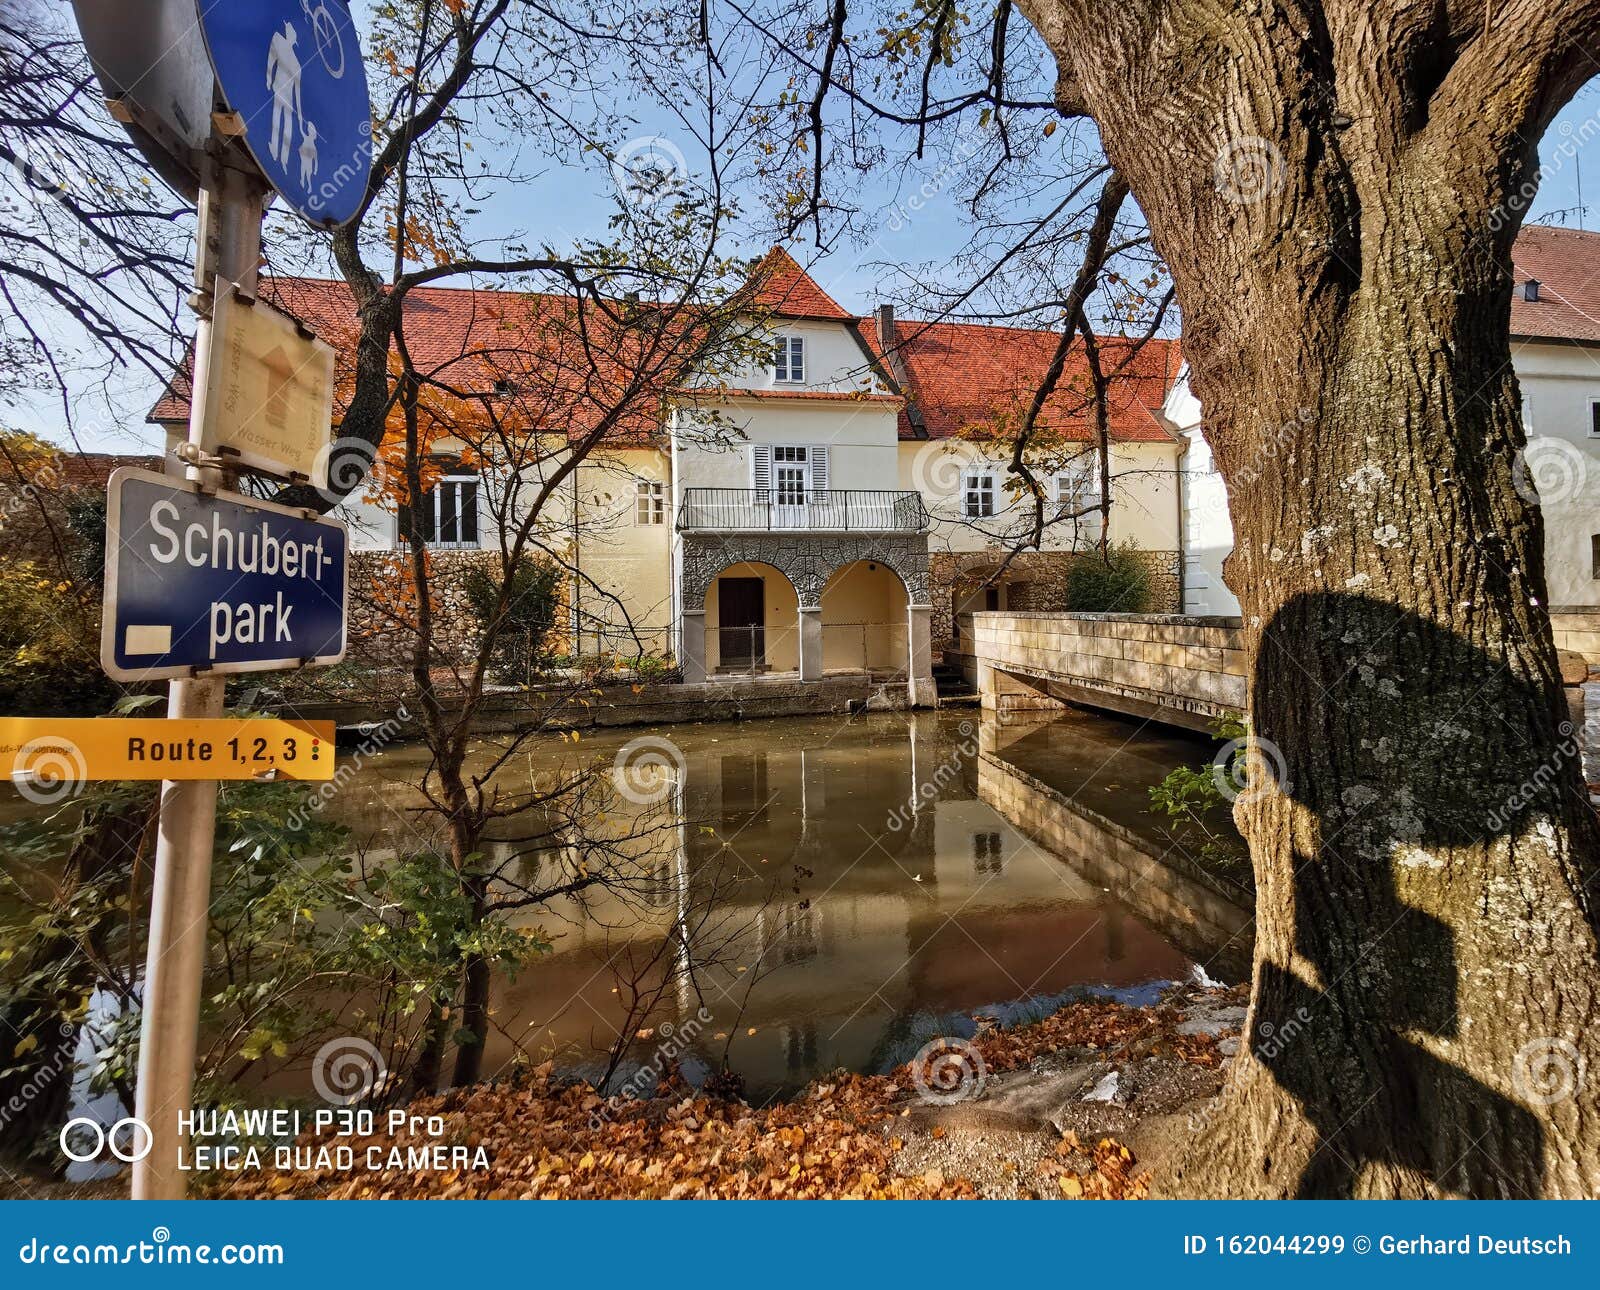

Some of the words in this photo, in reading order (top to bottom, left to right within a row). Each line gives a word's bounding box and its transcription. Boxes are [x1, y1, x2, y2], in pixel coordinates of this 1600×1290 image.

[150, 500, 332, 580] Schubert-
[209, 591, 293, 659] park
[128, 737, 213, 761] Route
